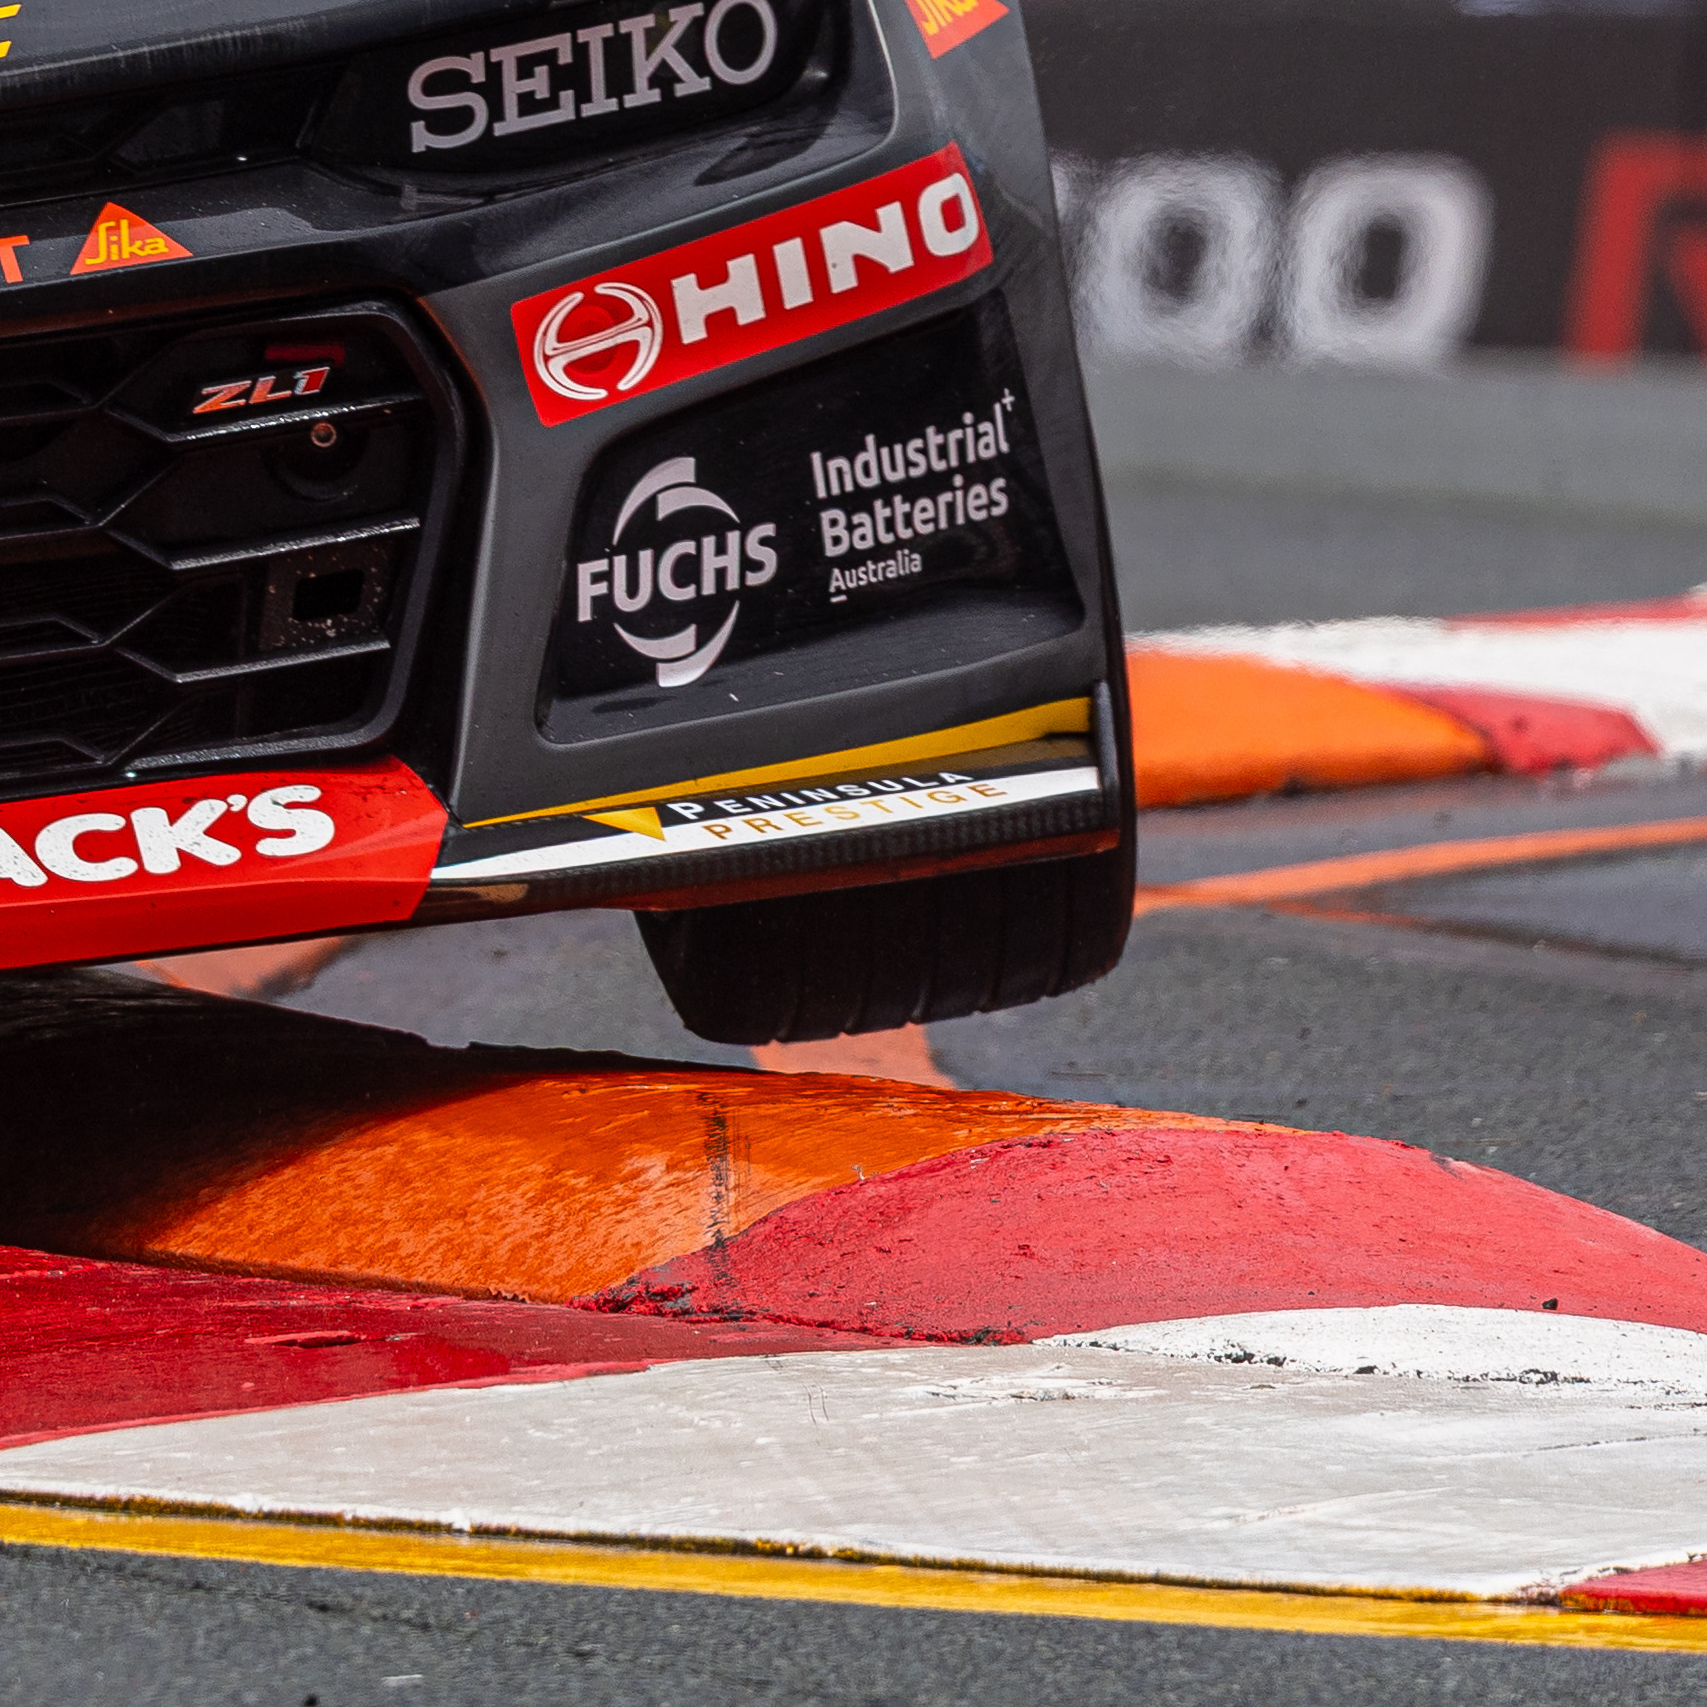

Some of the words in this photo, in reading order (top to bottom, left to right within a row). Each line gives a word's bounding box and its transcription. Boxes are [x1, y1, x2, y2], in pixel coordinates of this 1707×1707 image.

[85, 219, 169, 265] Sika
[671, 171, 981, 345] HINO
[192, 366, 330, 414] ZL1
[820, 476, 1010, 557] Batteries
[576, 522, 778, 623] FUCHS
[828, 549, 923, 594] Australia
[666, 768, 975, 820] PENINSULA
[700, 781, 1009, 841] PRESTIGE
